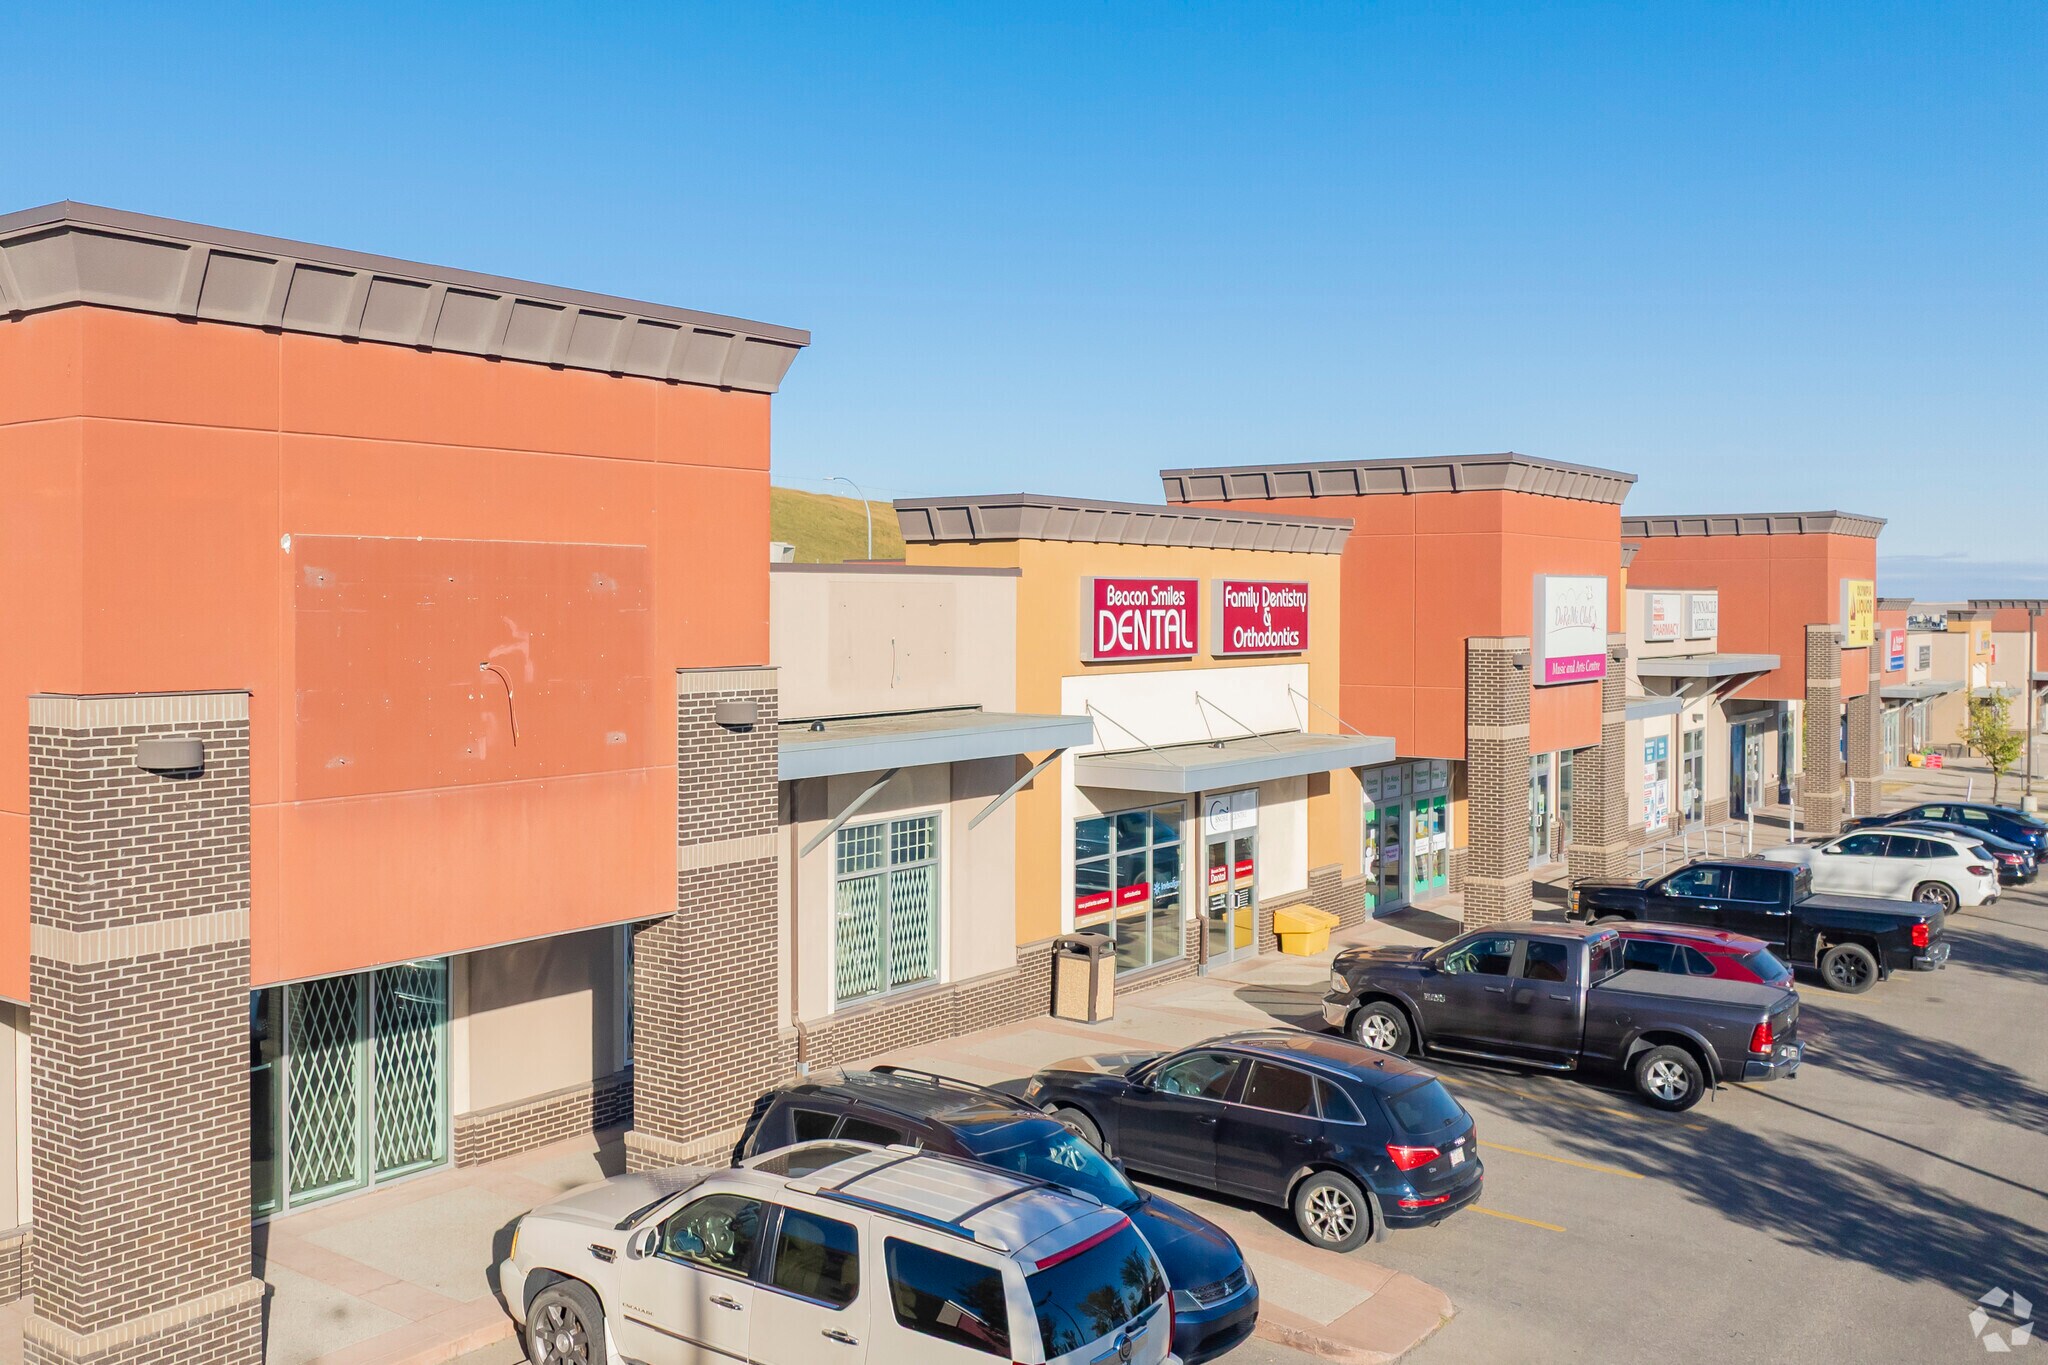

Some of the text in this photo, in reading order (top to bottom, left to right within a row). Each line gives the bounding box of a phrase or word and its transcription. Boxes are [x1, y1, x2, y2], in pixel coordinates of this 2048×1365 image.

[1107, 584, 1186, 606] Beacon Smiles
[1225, 586, 1306, 613] Family Dentistry
[1263, 607, 1272, 627] &
[1098, 608, 1194, 652] DENTAL
[1233, 626, 1299, 648] Orthodontics
[1652, 623, 1679, 636] PHARMACY
[1552, 662, 1567, 675] Music
[1566, 660, 1576, 673] and
[1576, 661, 1585, 673] Arts
